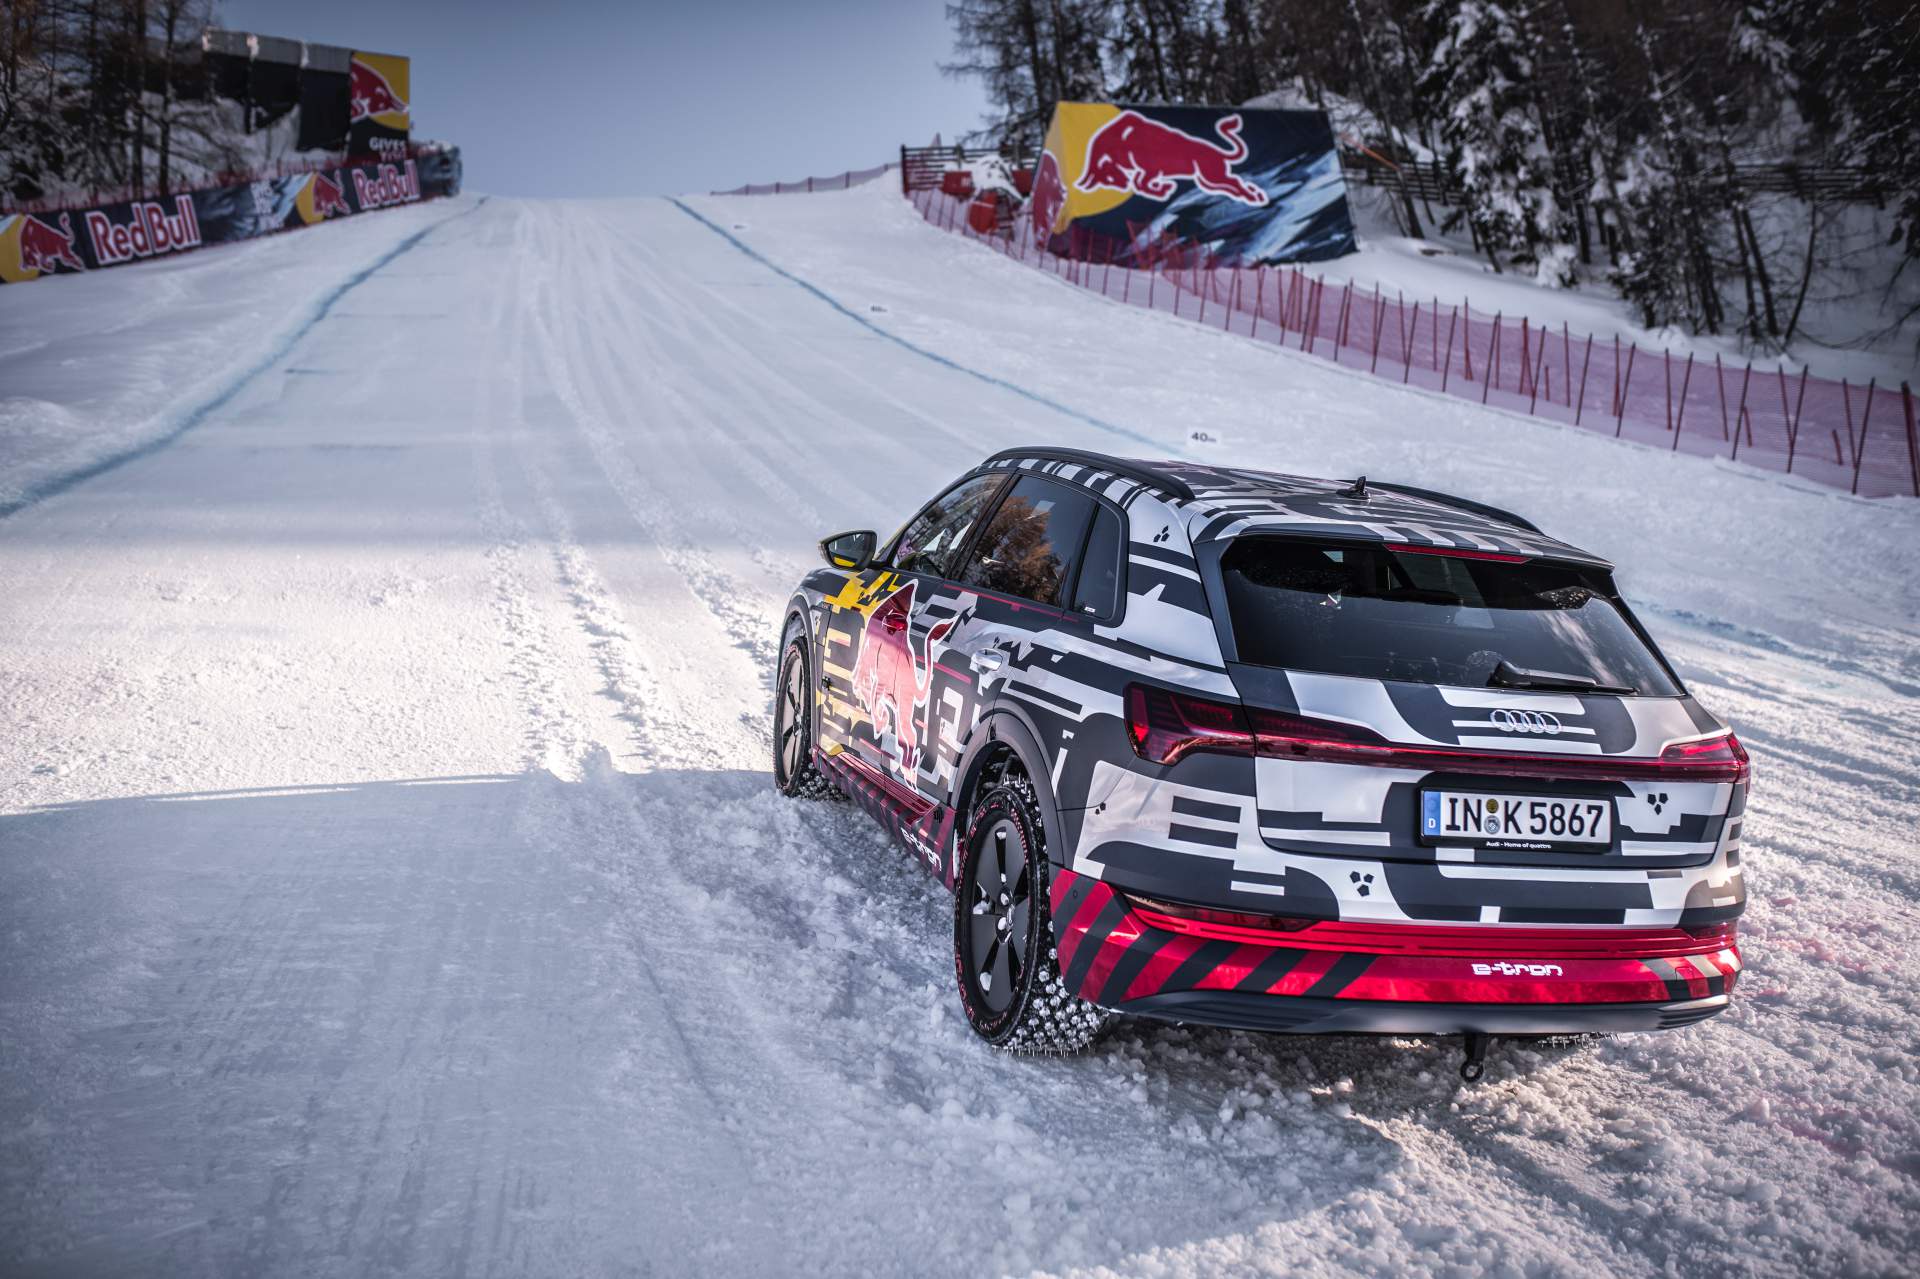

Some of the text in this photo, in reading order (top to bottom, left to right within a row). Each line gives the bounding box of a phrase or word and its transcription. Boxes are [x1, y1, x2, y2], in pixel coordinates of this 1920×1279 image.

[352, 159, 420, 210] Red Bull
[85, 202, 154, 265] Red
[143, 194, 201, 254] Bull
[1428, 817, 1436, 829] D
[1445, 797, 1604, 838] IN K 5867
[901, 827, 942, 871] e-tron
[1471, 961, 1564, 977] e-tron
